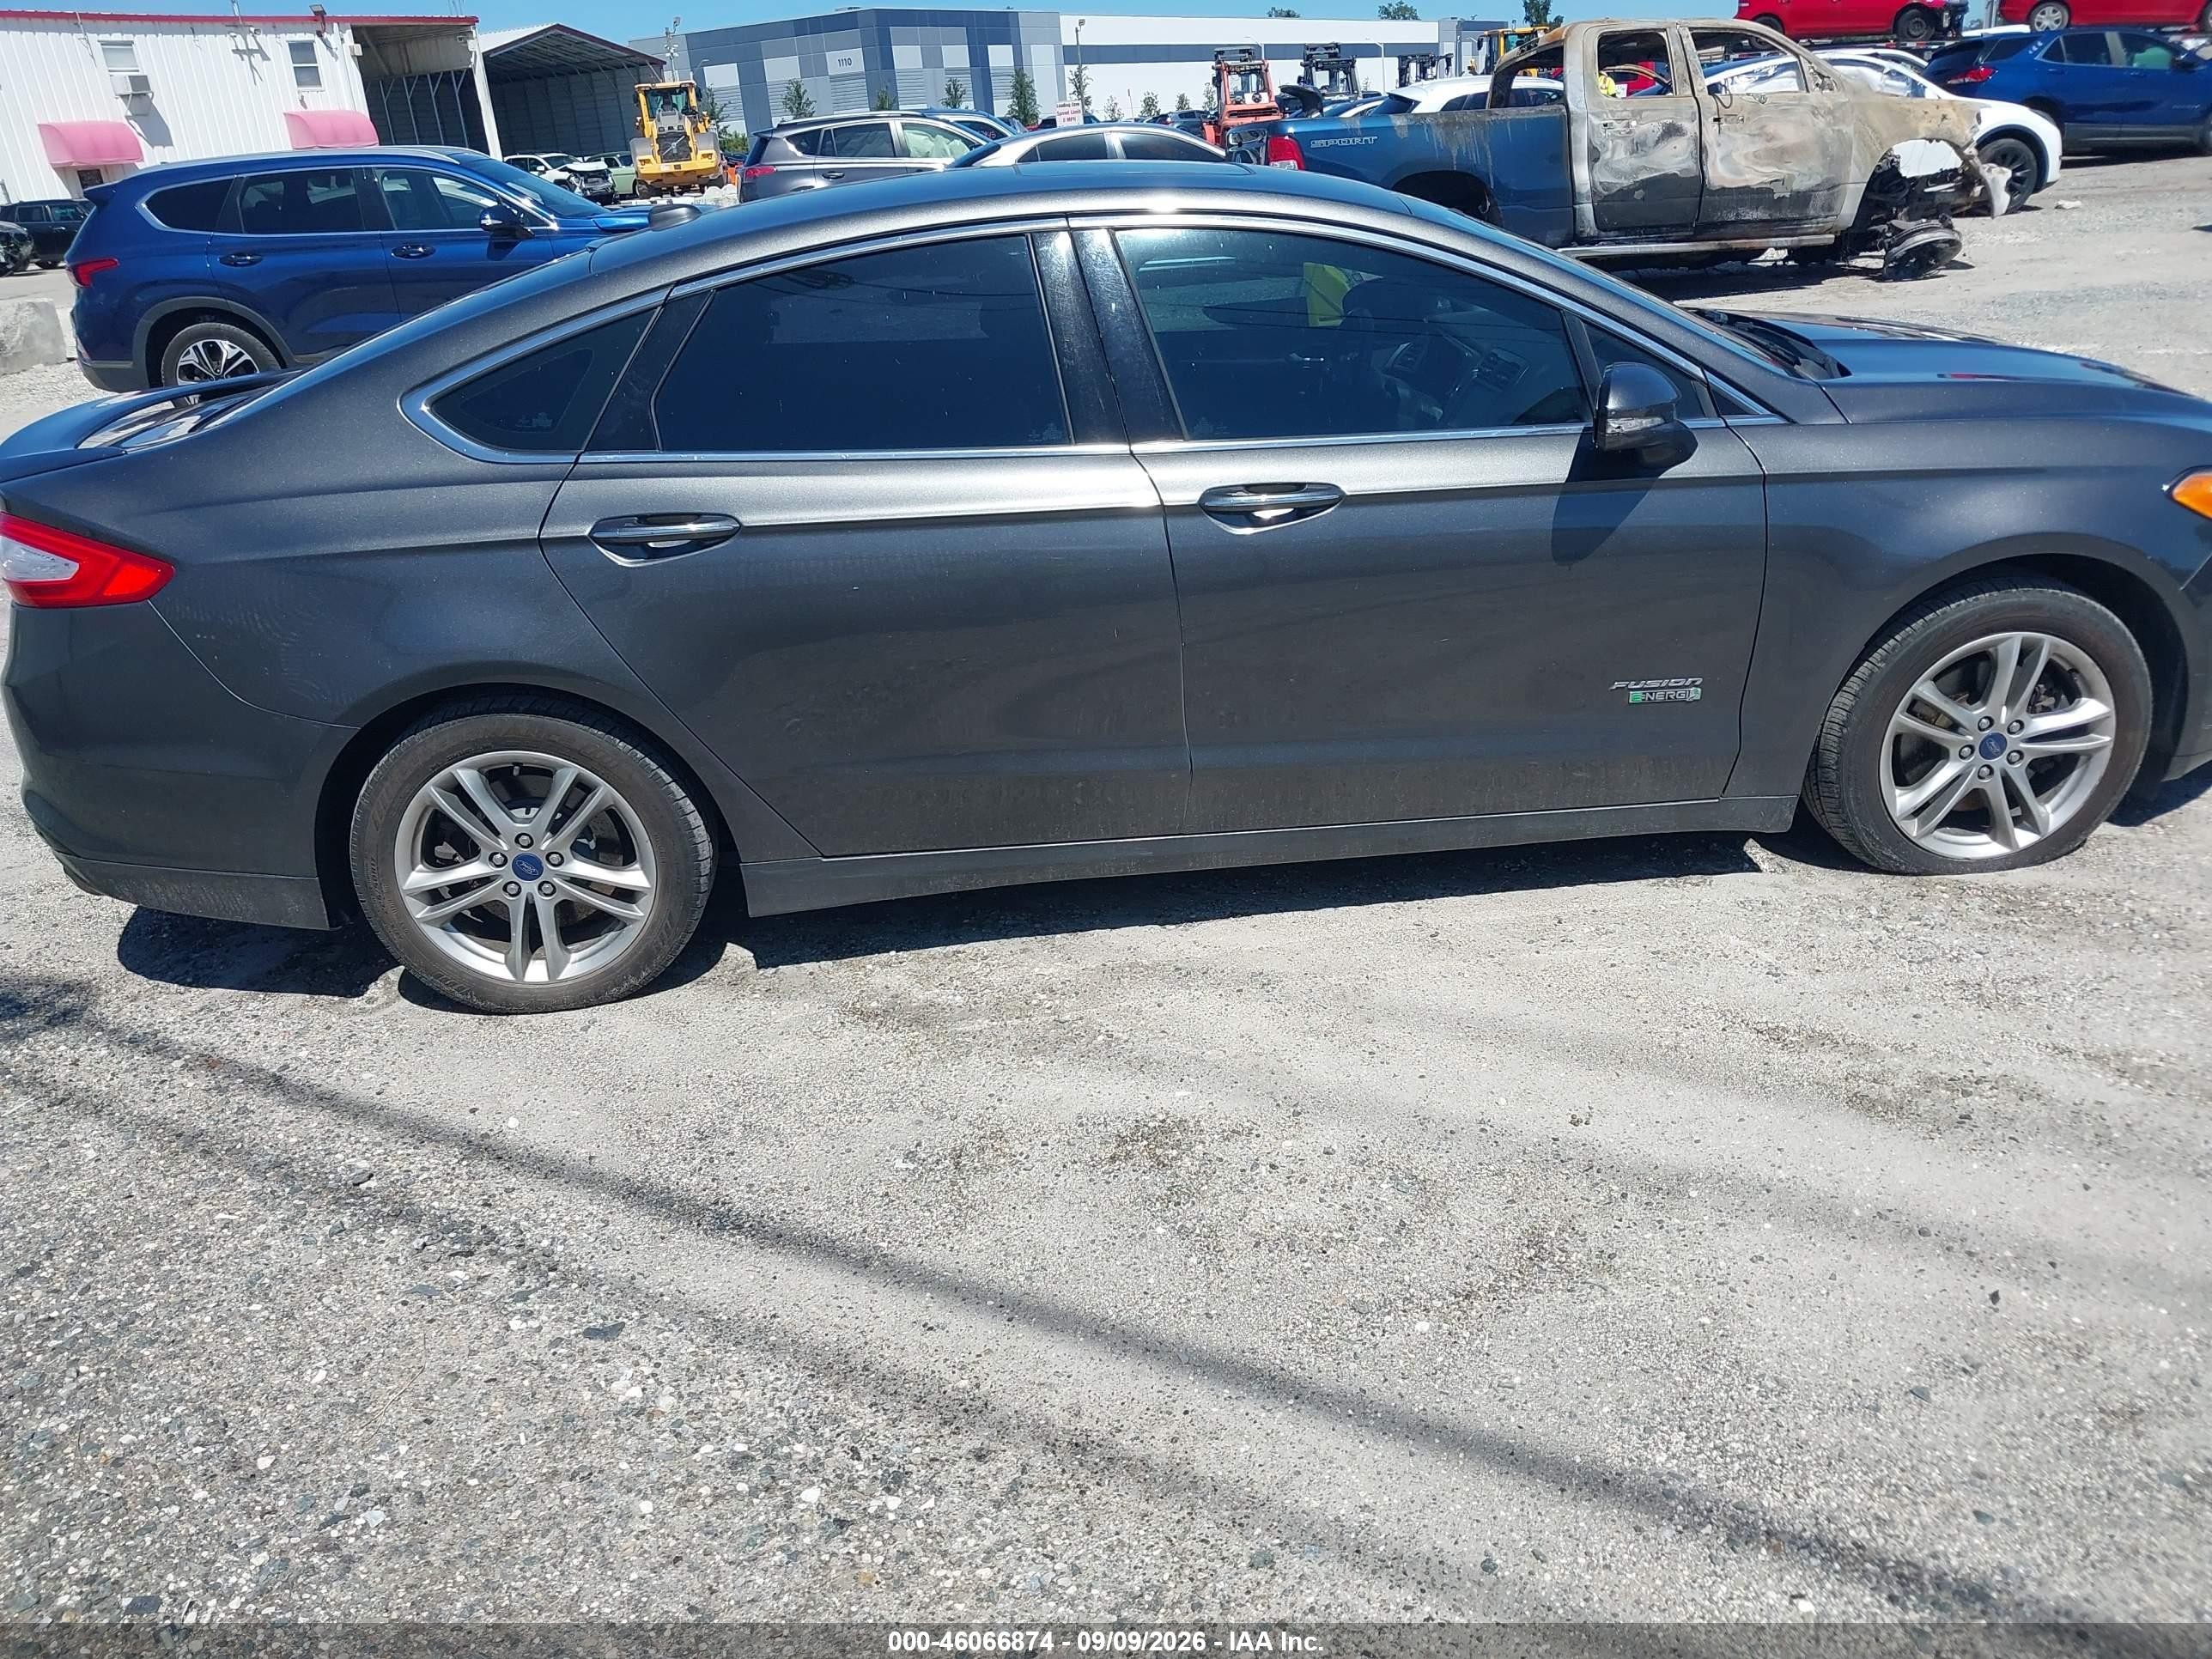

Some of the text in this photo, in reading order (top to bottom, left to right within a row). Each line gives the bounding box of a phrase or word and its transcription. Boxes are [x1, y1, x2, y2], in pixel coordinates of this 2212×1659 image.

[837, 58, 853, 67] 1110
[1310, 136, 1378, 148] SPORT
[1609, 678, 1704, 690] FUSION
[1630, 688, 1691, 702] ENERGI
